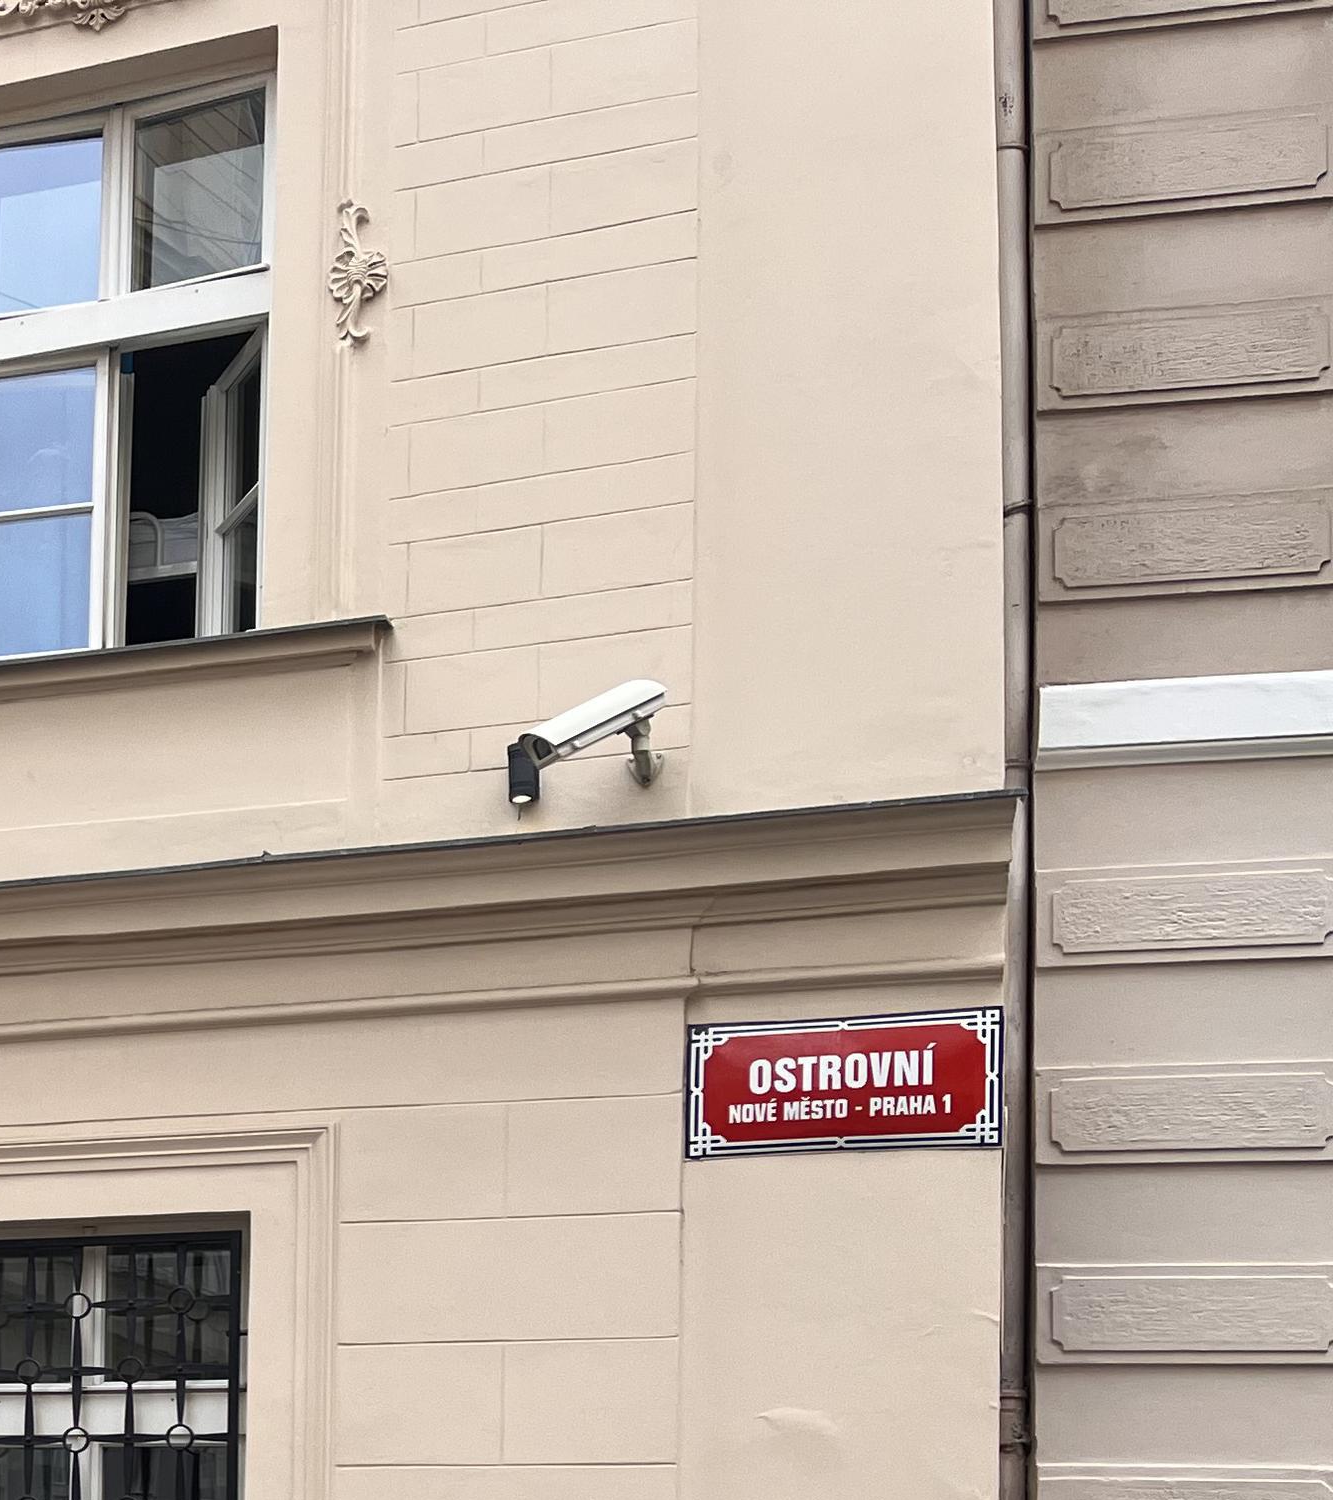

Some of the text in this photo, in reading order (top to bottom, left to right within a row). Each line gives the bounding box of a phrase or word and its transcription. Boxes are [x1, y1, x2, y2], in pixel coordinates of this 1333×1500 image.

[749, 1043, 938, 1095] OSTROVNÍ
[728, 1098, 777, 1124] NOVÉ
[783, 1096, 849, 1121] MĚSTO
[869, 1095, 937, 1118] PRAHA
[942, 1095, 952, 1114] 1
